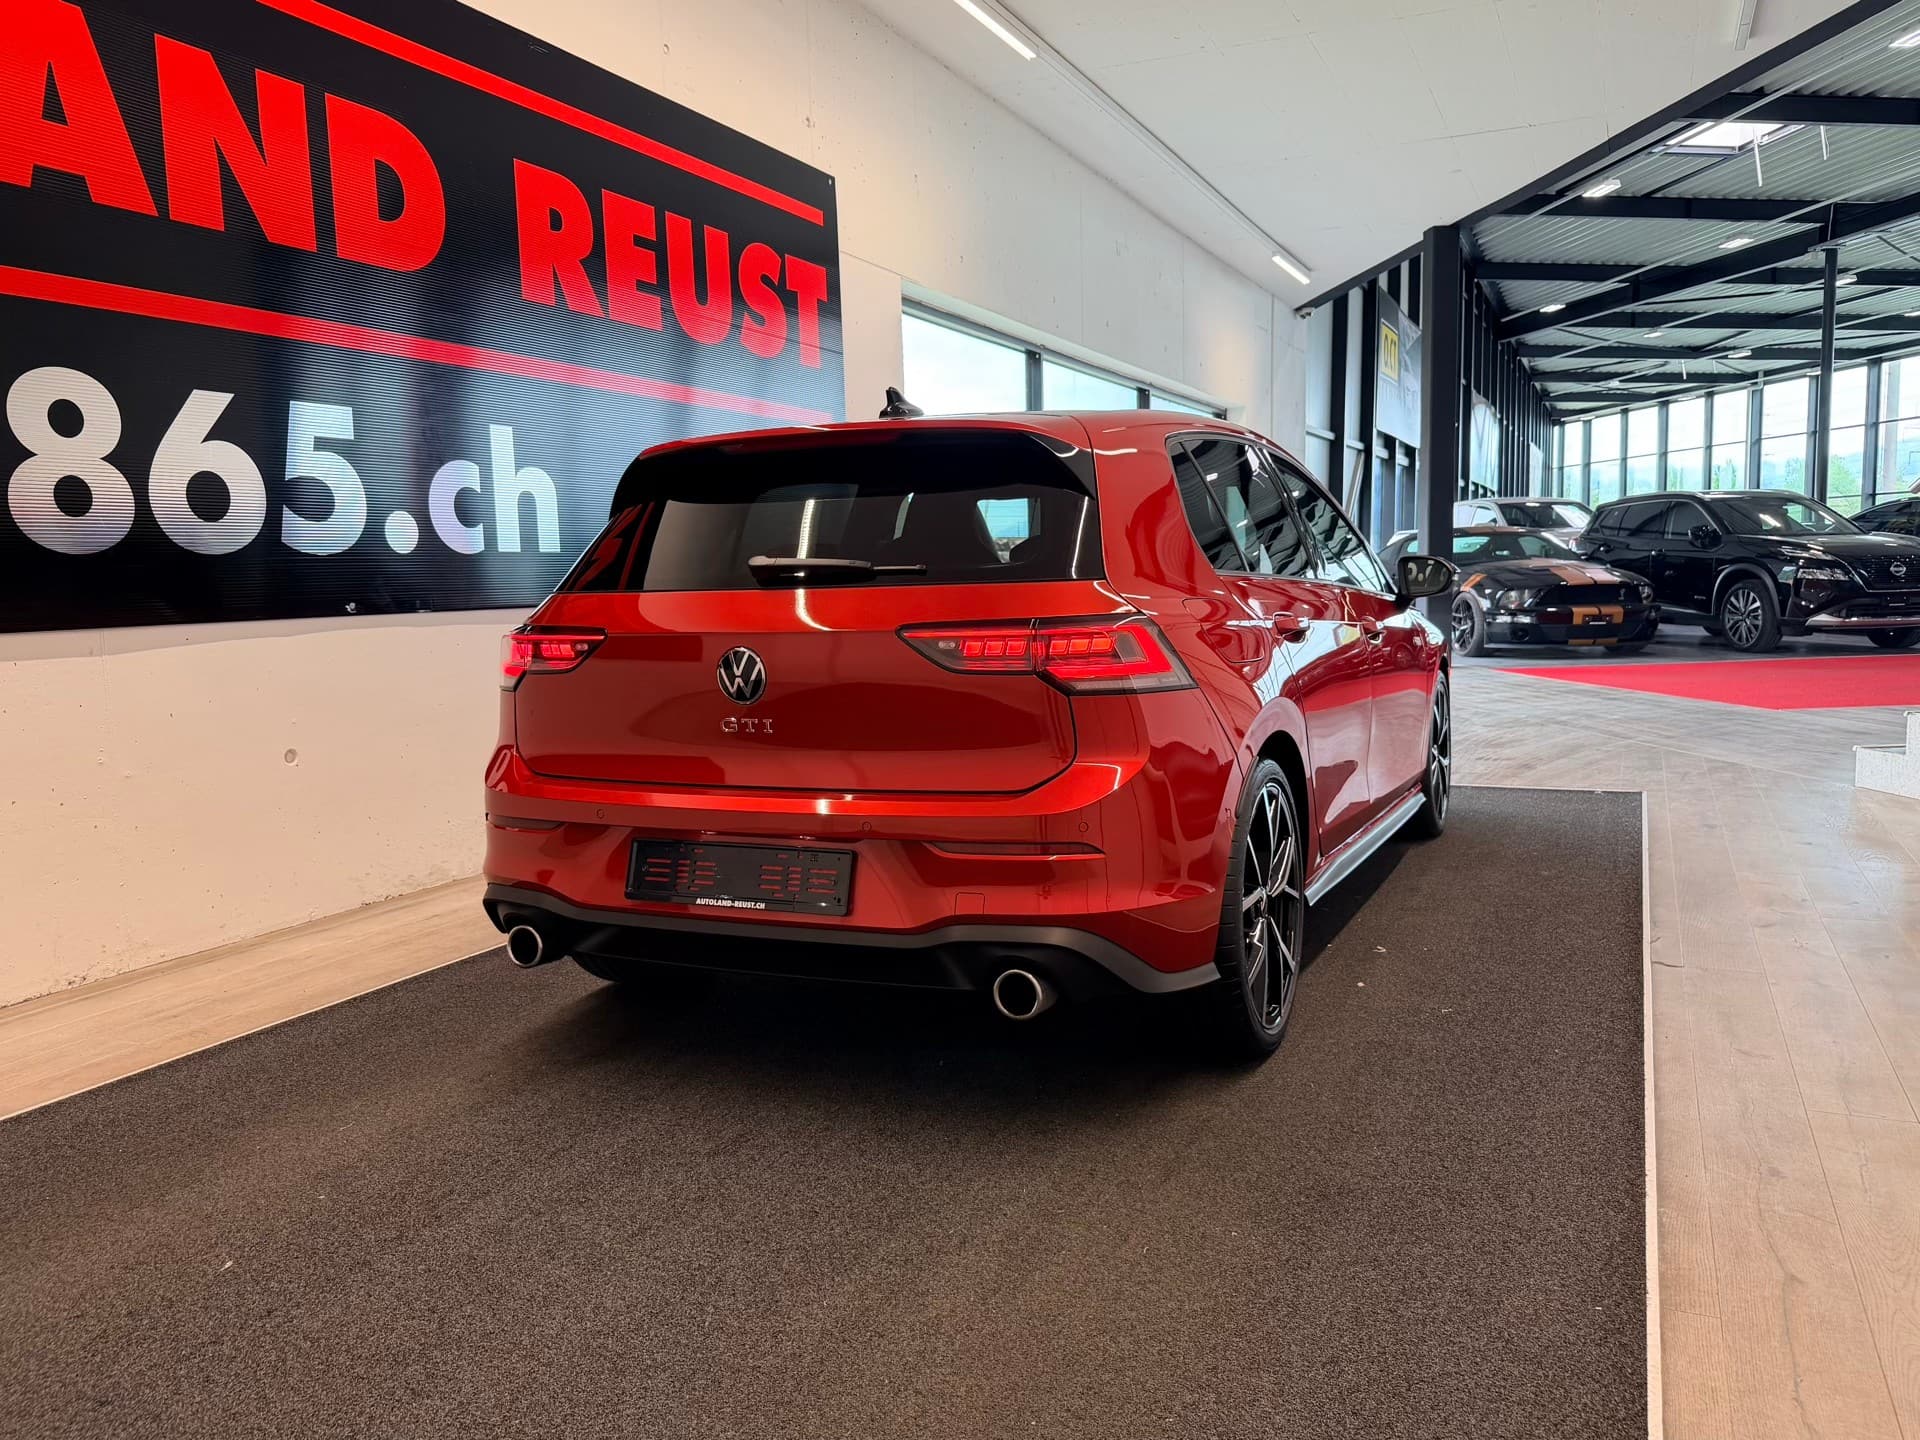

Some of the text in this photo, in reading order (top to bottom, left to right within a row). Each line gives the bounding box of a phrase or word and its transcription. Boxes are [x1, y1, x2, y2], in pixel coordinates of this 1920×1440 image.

[513, 158, 828, 369] REUST
[5, 366, 561, 557] 865.ch
[721, 716, 774, 734] GTI
[695, 897, 766, 910] AUTOLAND-REUST.CH
